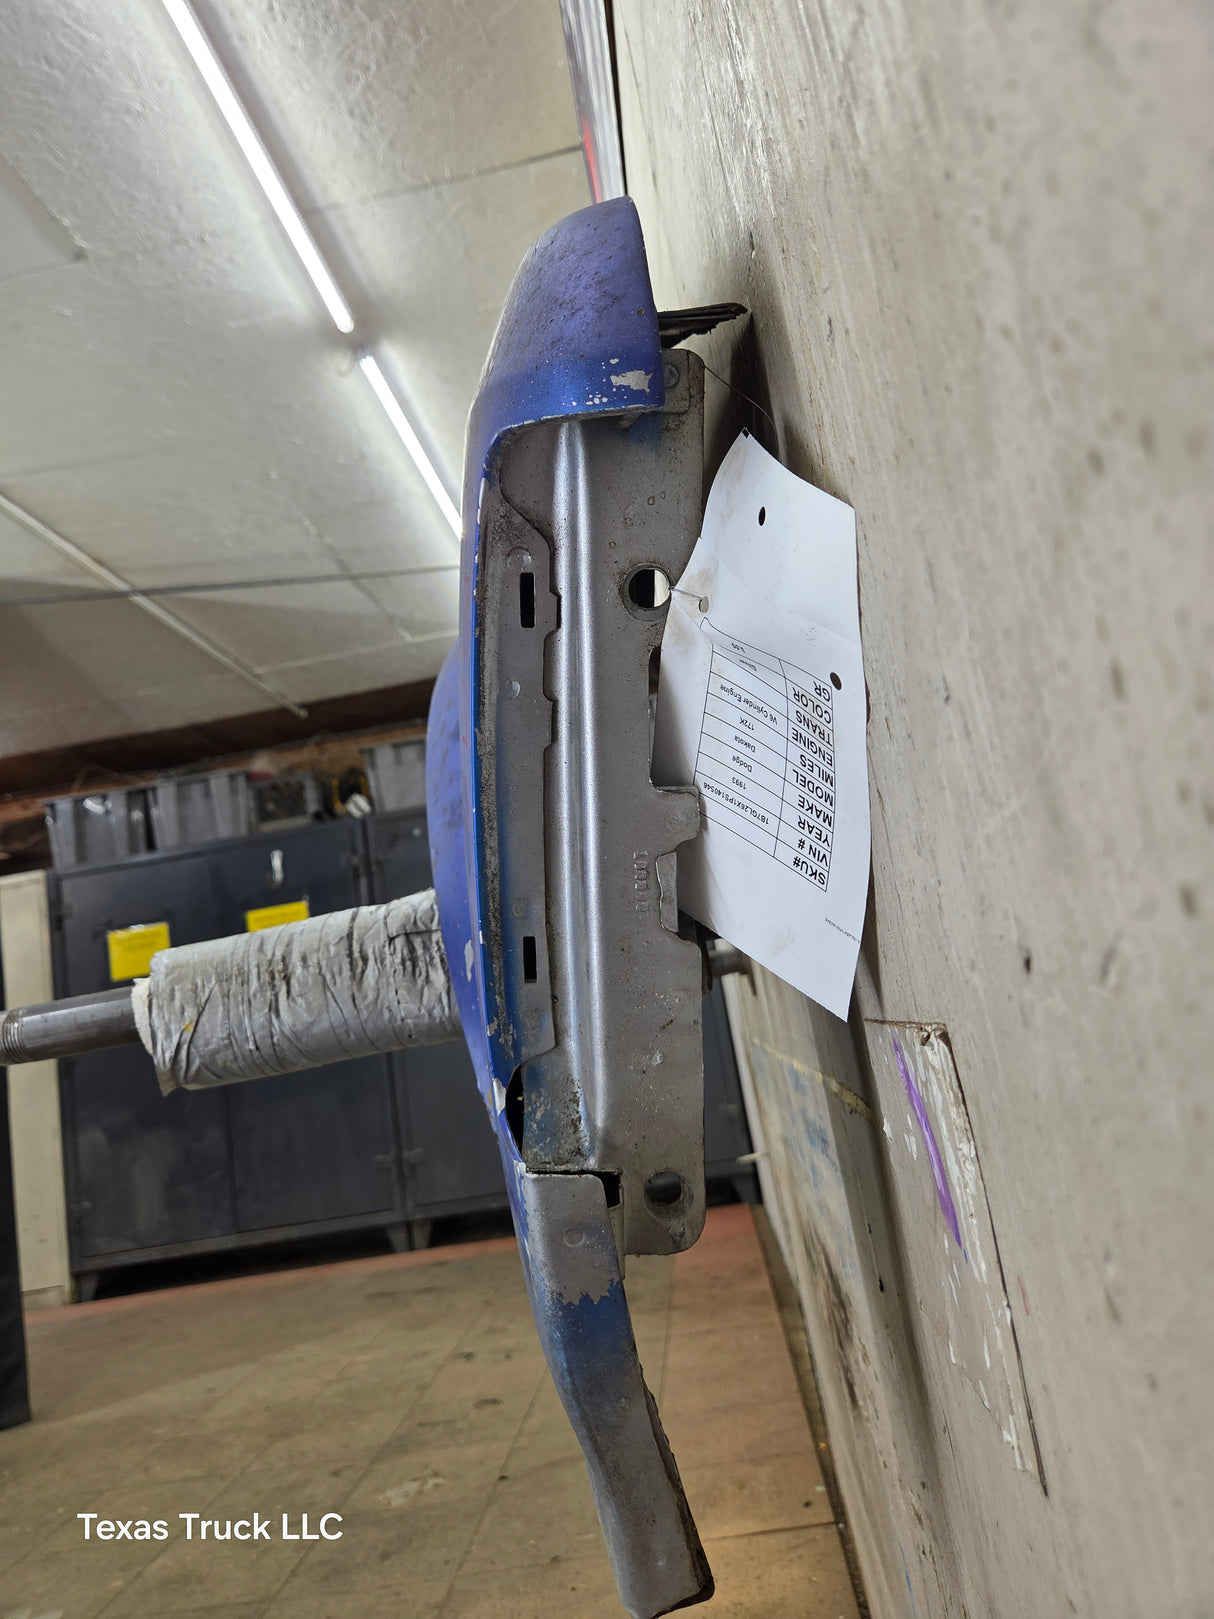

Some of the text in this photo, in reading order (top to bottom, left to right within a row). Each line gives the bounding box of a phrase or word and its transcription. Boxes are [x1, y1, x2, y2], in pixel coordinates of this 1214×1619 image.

[719, 684, 778, 725] V6 Cylinder Engine
[792, 687, 831, 724] COLOR
[813, 681, 830, 702] GR
[740, 716, 755, 731] 172K
[796, 710, 832, 747] TRANS
[734, 735, 756, 753] Dakota
[791, 727, 832, 767] ENGINE
[732, 755, 752, 773] Dodge
[800, 754, 833, 787] MILES
[732, 776, 746, 790] 1993
[792, 769, 833, 807] MODEL
[798, 794, 832, 827] MAKE
[798, 815, 830, 848] YEAR
[798, 838, 828, 867] VIN #
[793, 856, 826, 885] SKU#
